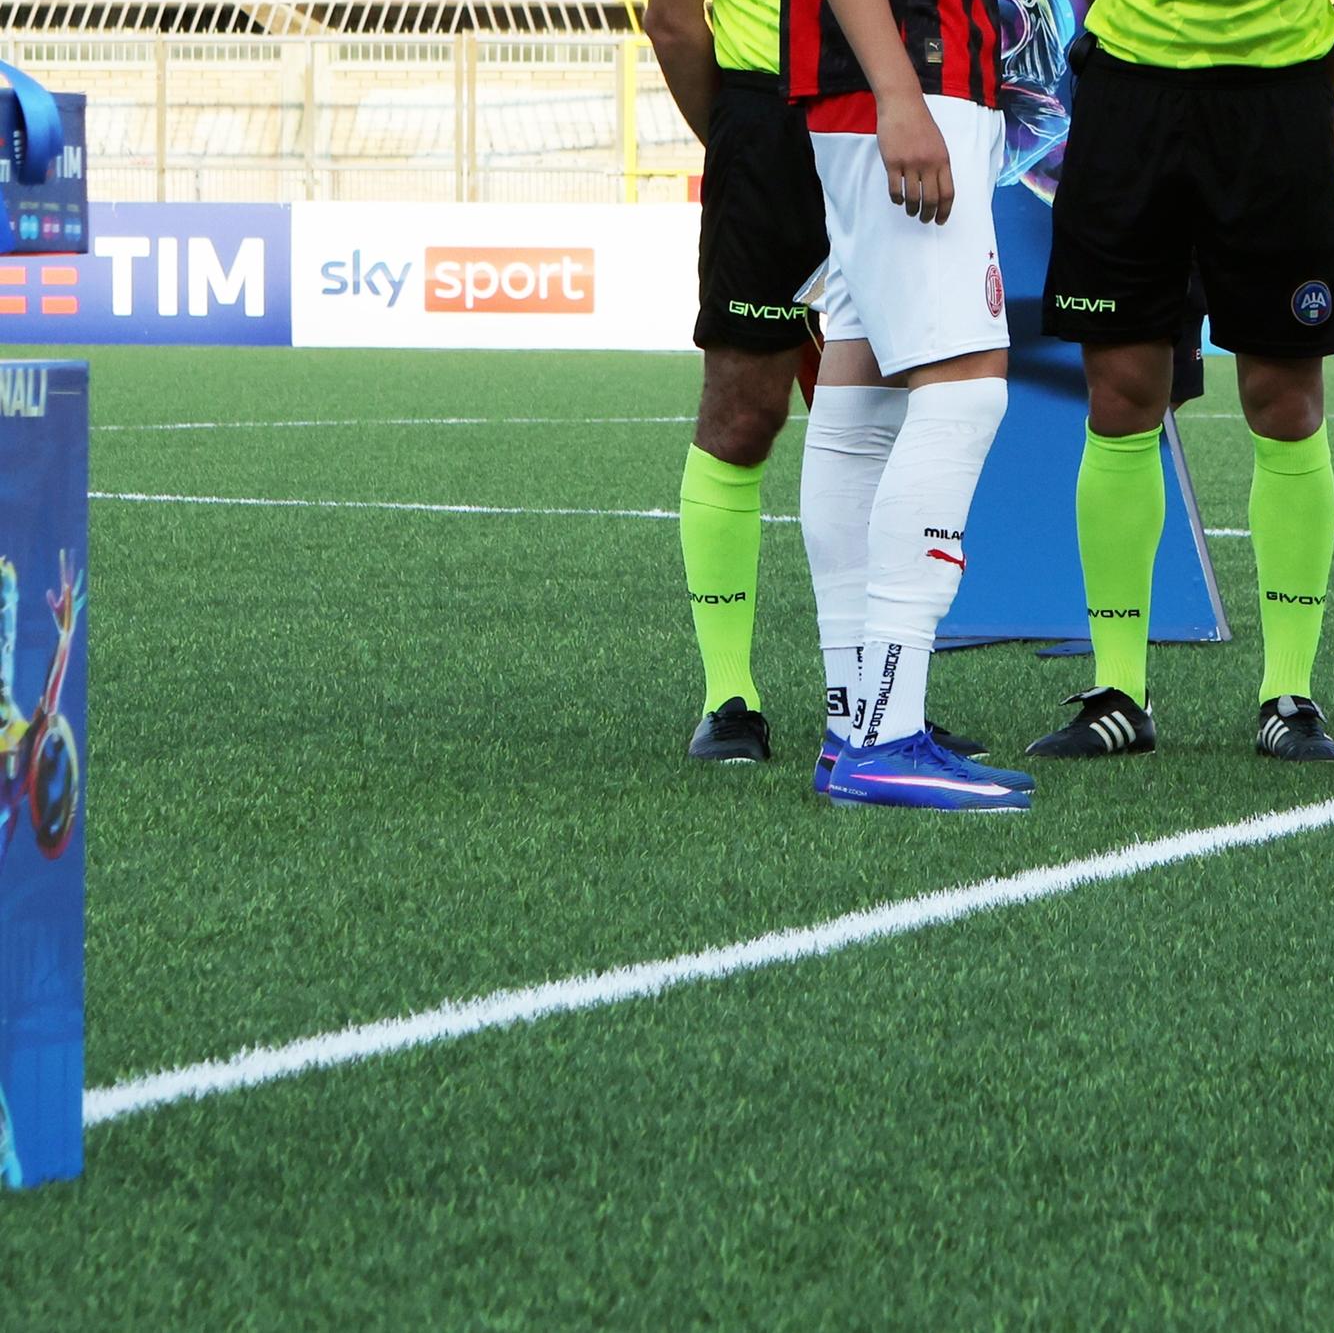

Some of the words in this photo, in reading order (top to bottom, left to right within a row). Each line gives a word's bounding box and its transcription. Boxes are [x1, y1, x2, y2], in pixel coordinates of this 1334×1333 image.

[95, 236, 264, 318] TIM
[320, 249, 413, 308] sky
[433, 255, 585, 308] sport
[729, 300, 808, 320] GIVOVA
